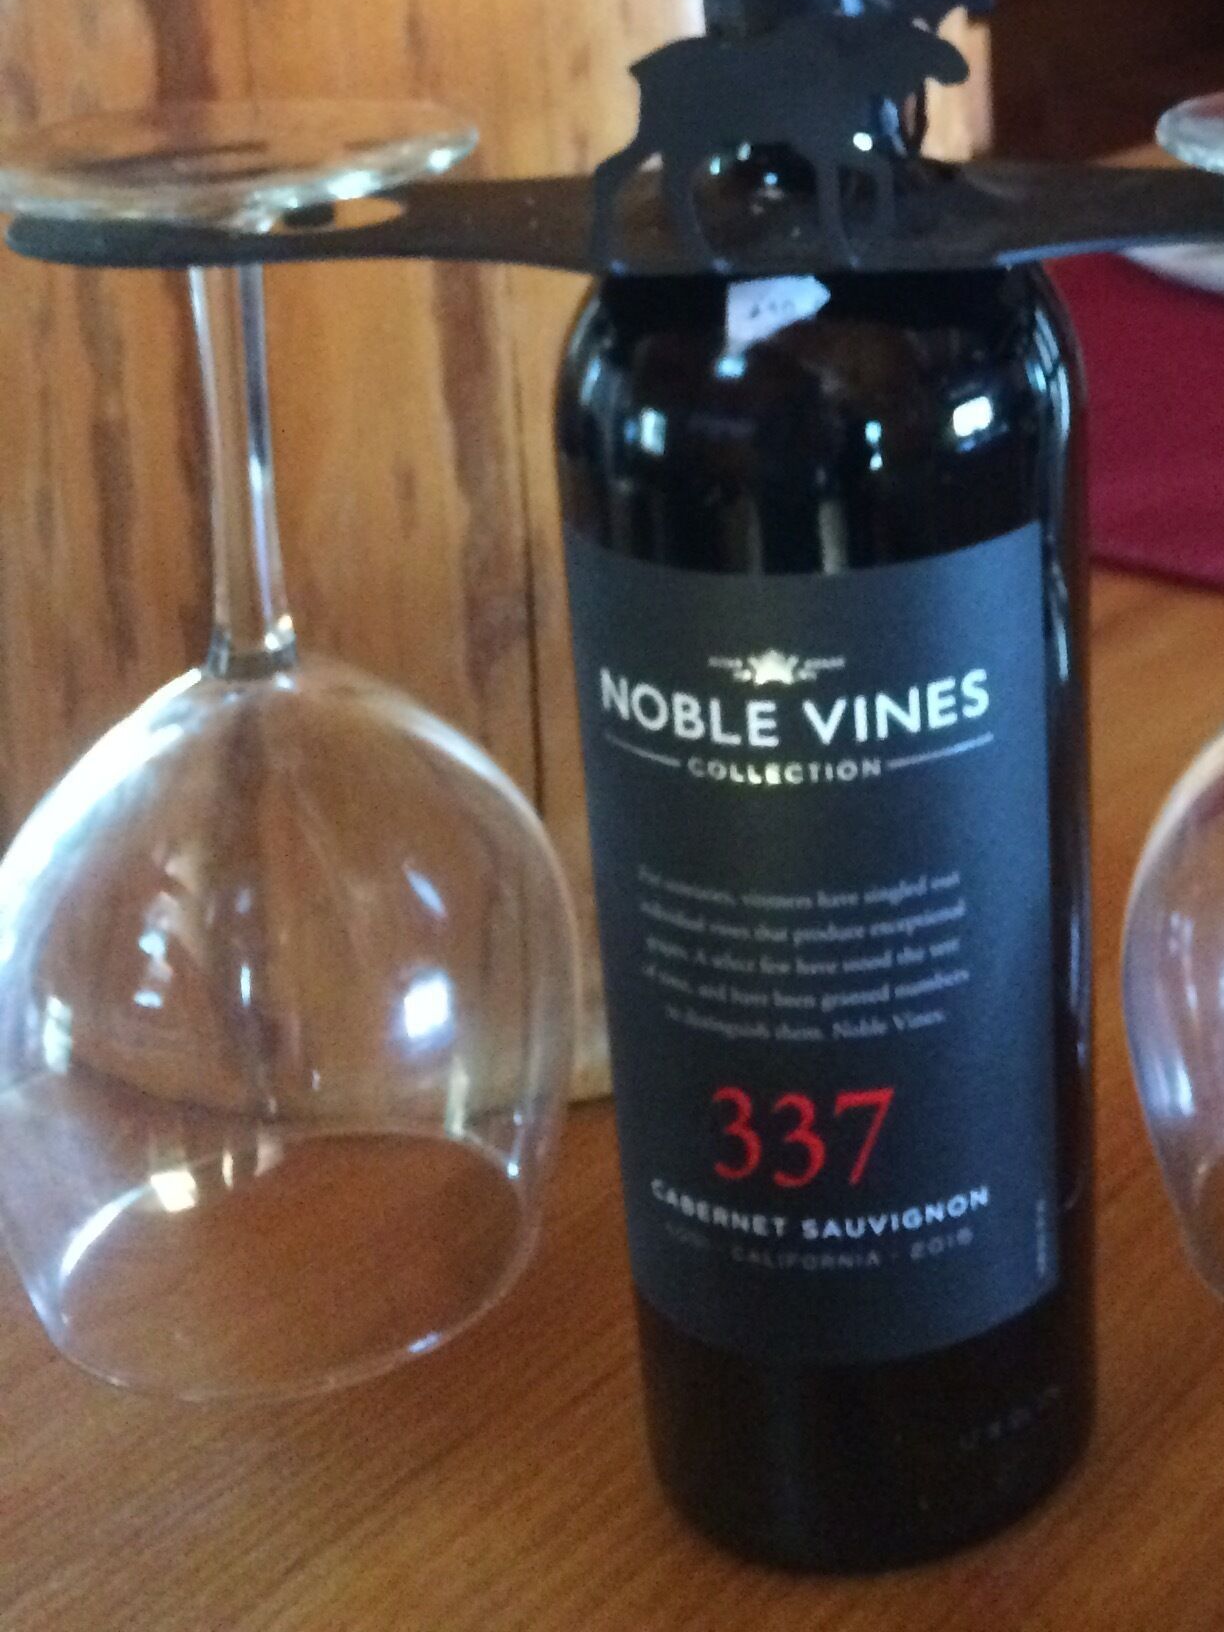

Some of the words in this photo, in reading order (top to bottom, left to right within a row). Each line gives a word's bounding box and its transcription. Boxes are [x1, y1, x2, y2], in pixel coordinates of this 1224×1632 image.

[600, 667, 780, 747] NOBLE
[802, 668, 991, 746] VINES
[686, 755, 883, 785] COLLECTION
[711, 1085, 896, 1187] 337
[650, 1177, 788, 1237] CABERNET
[801, 1184, 991, 1240] SAUVIGNON
